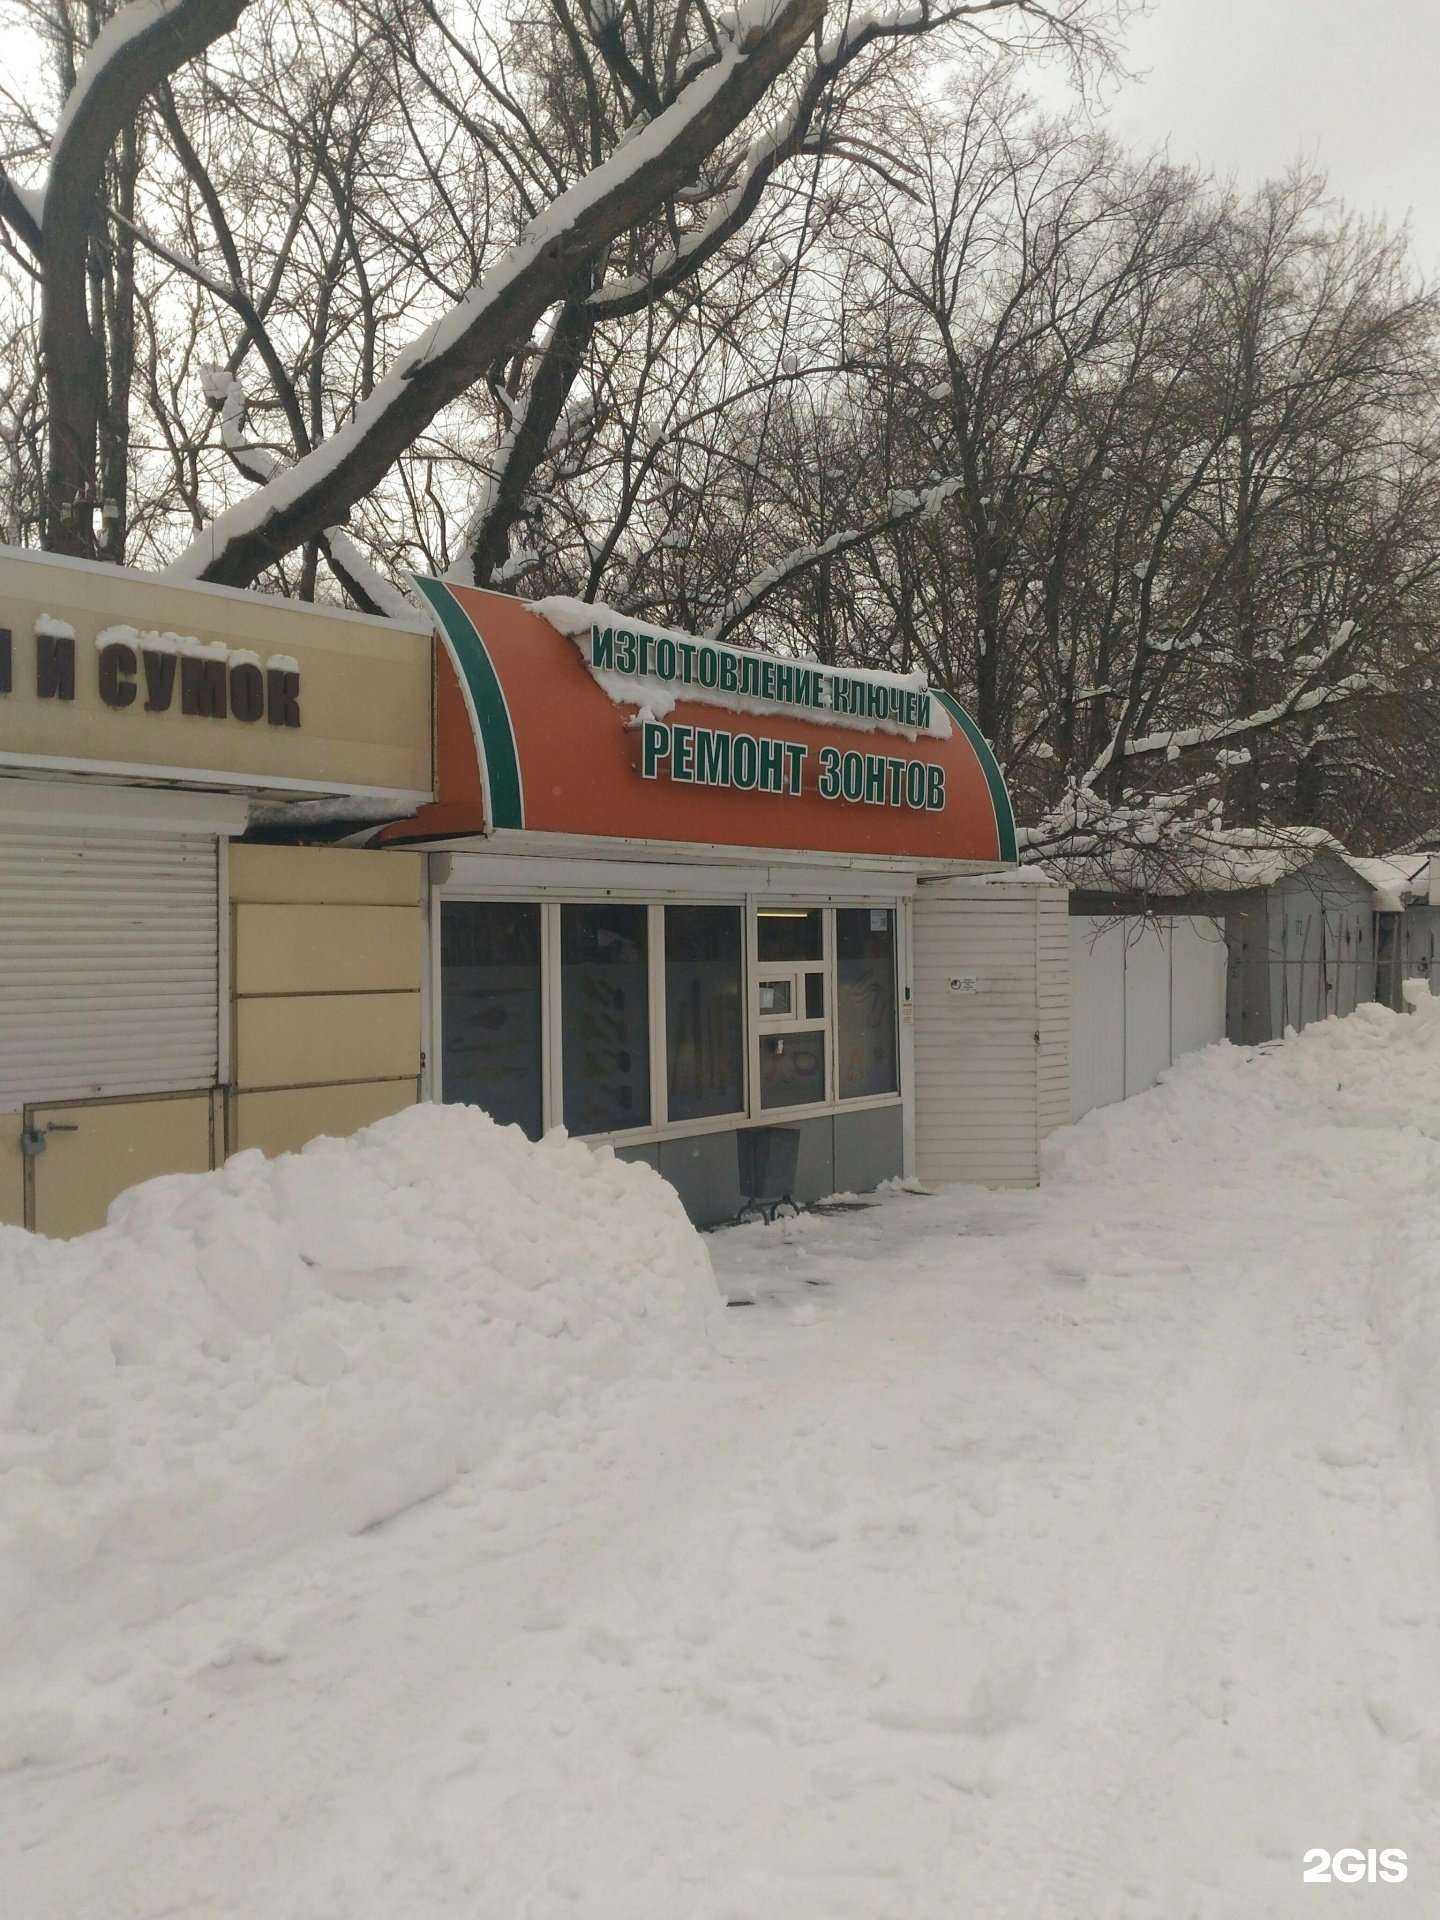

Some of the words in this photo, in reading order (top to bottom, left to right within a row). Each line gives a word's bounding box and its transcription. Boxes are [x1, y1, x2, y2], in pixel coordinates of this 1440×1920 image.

[98, 643, 301, 728] СУМОК
[591, 624, 826, 711] ИЗГОТОВЛЕНИЕ
[831, 674, 932, 729] КЛЮЧЕЙ
[641, 719, 808, 797] РЕМОНТ
[818, 746, 946, 812] ЗОНТОВ
